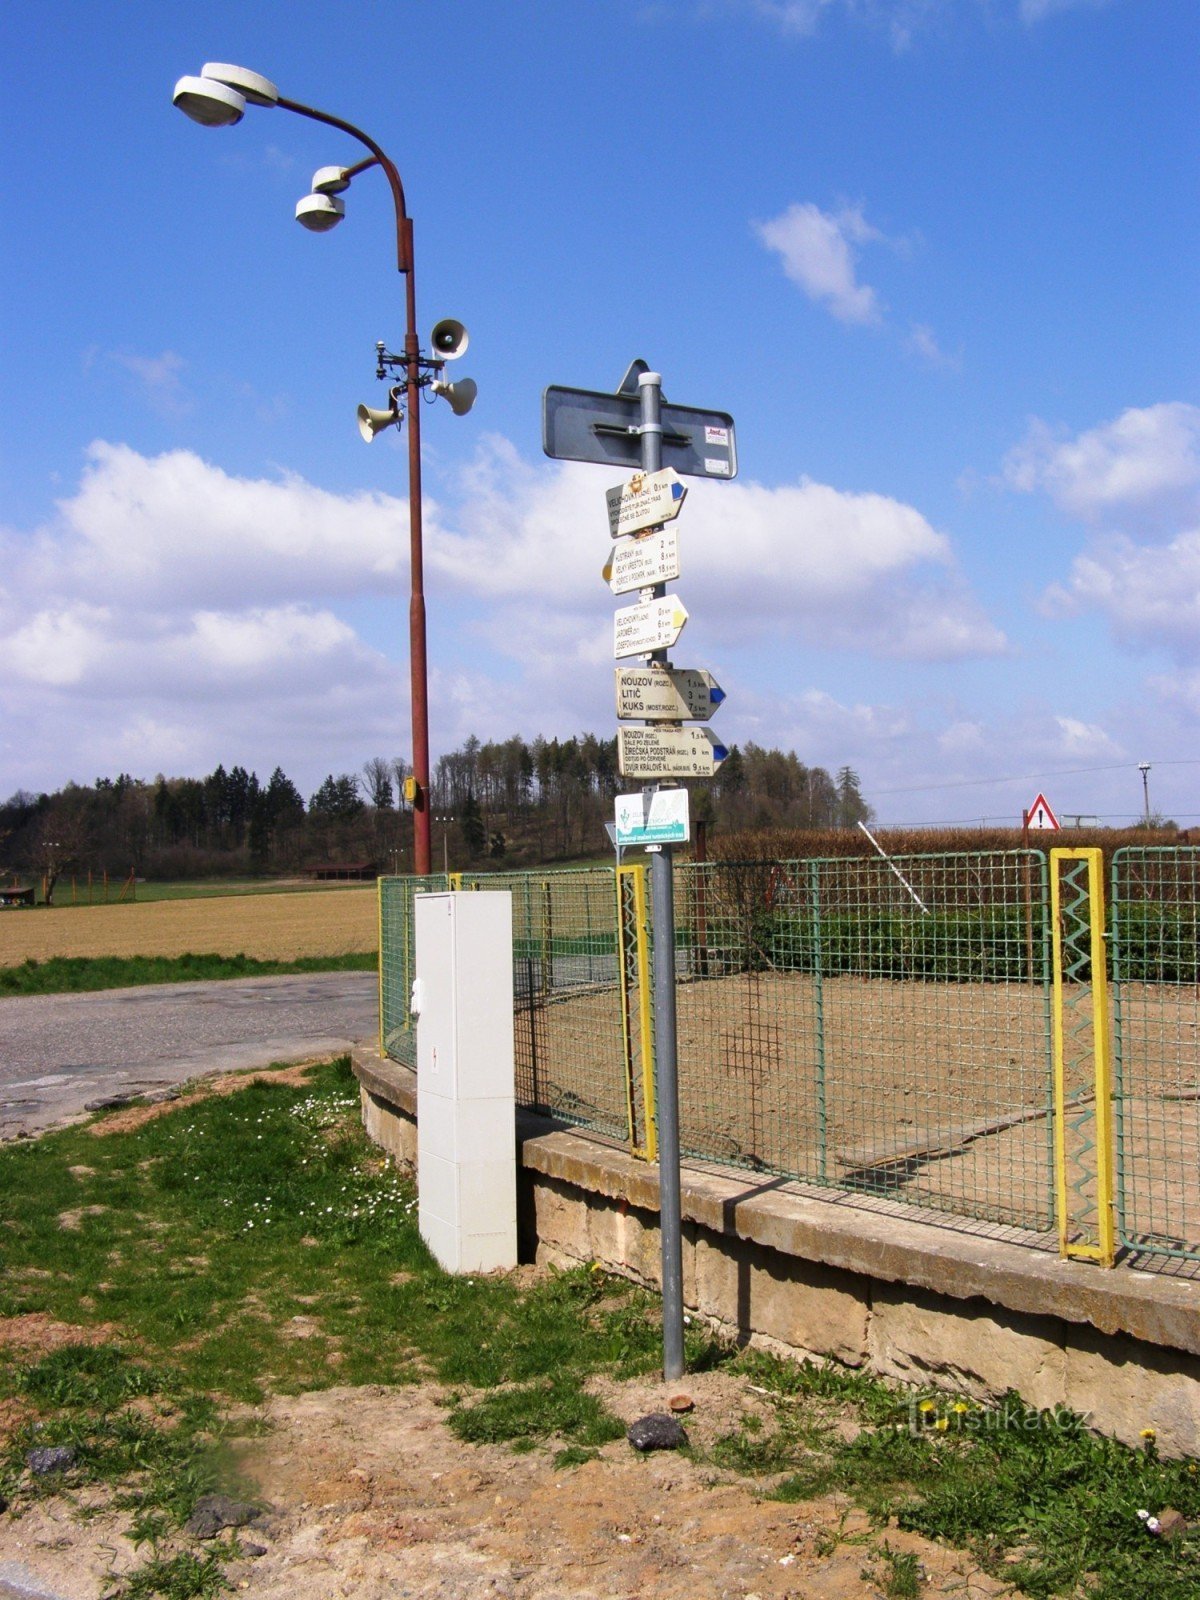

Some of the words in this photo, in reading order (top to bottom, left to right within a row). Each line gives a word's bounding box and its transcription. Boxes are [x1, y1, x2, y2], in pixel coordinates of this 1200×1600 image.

[621, 677, 653, 687] NOUZOV
[697, 679, 706, 687] km
[622, 689, 641, 698] LITIČ
[688, 691, 693, 700] 3
[622, 702, 644, 711] KUKS
[623, 730, 645, 739] NOUZOV
[691, 747, 697, 756] 6
[639, 761, 662, 772] KRÁLOVÉ
